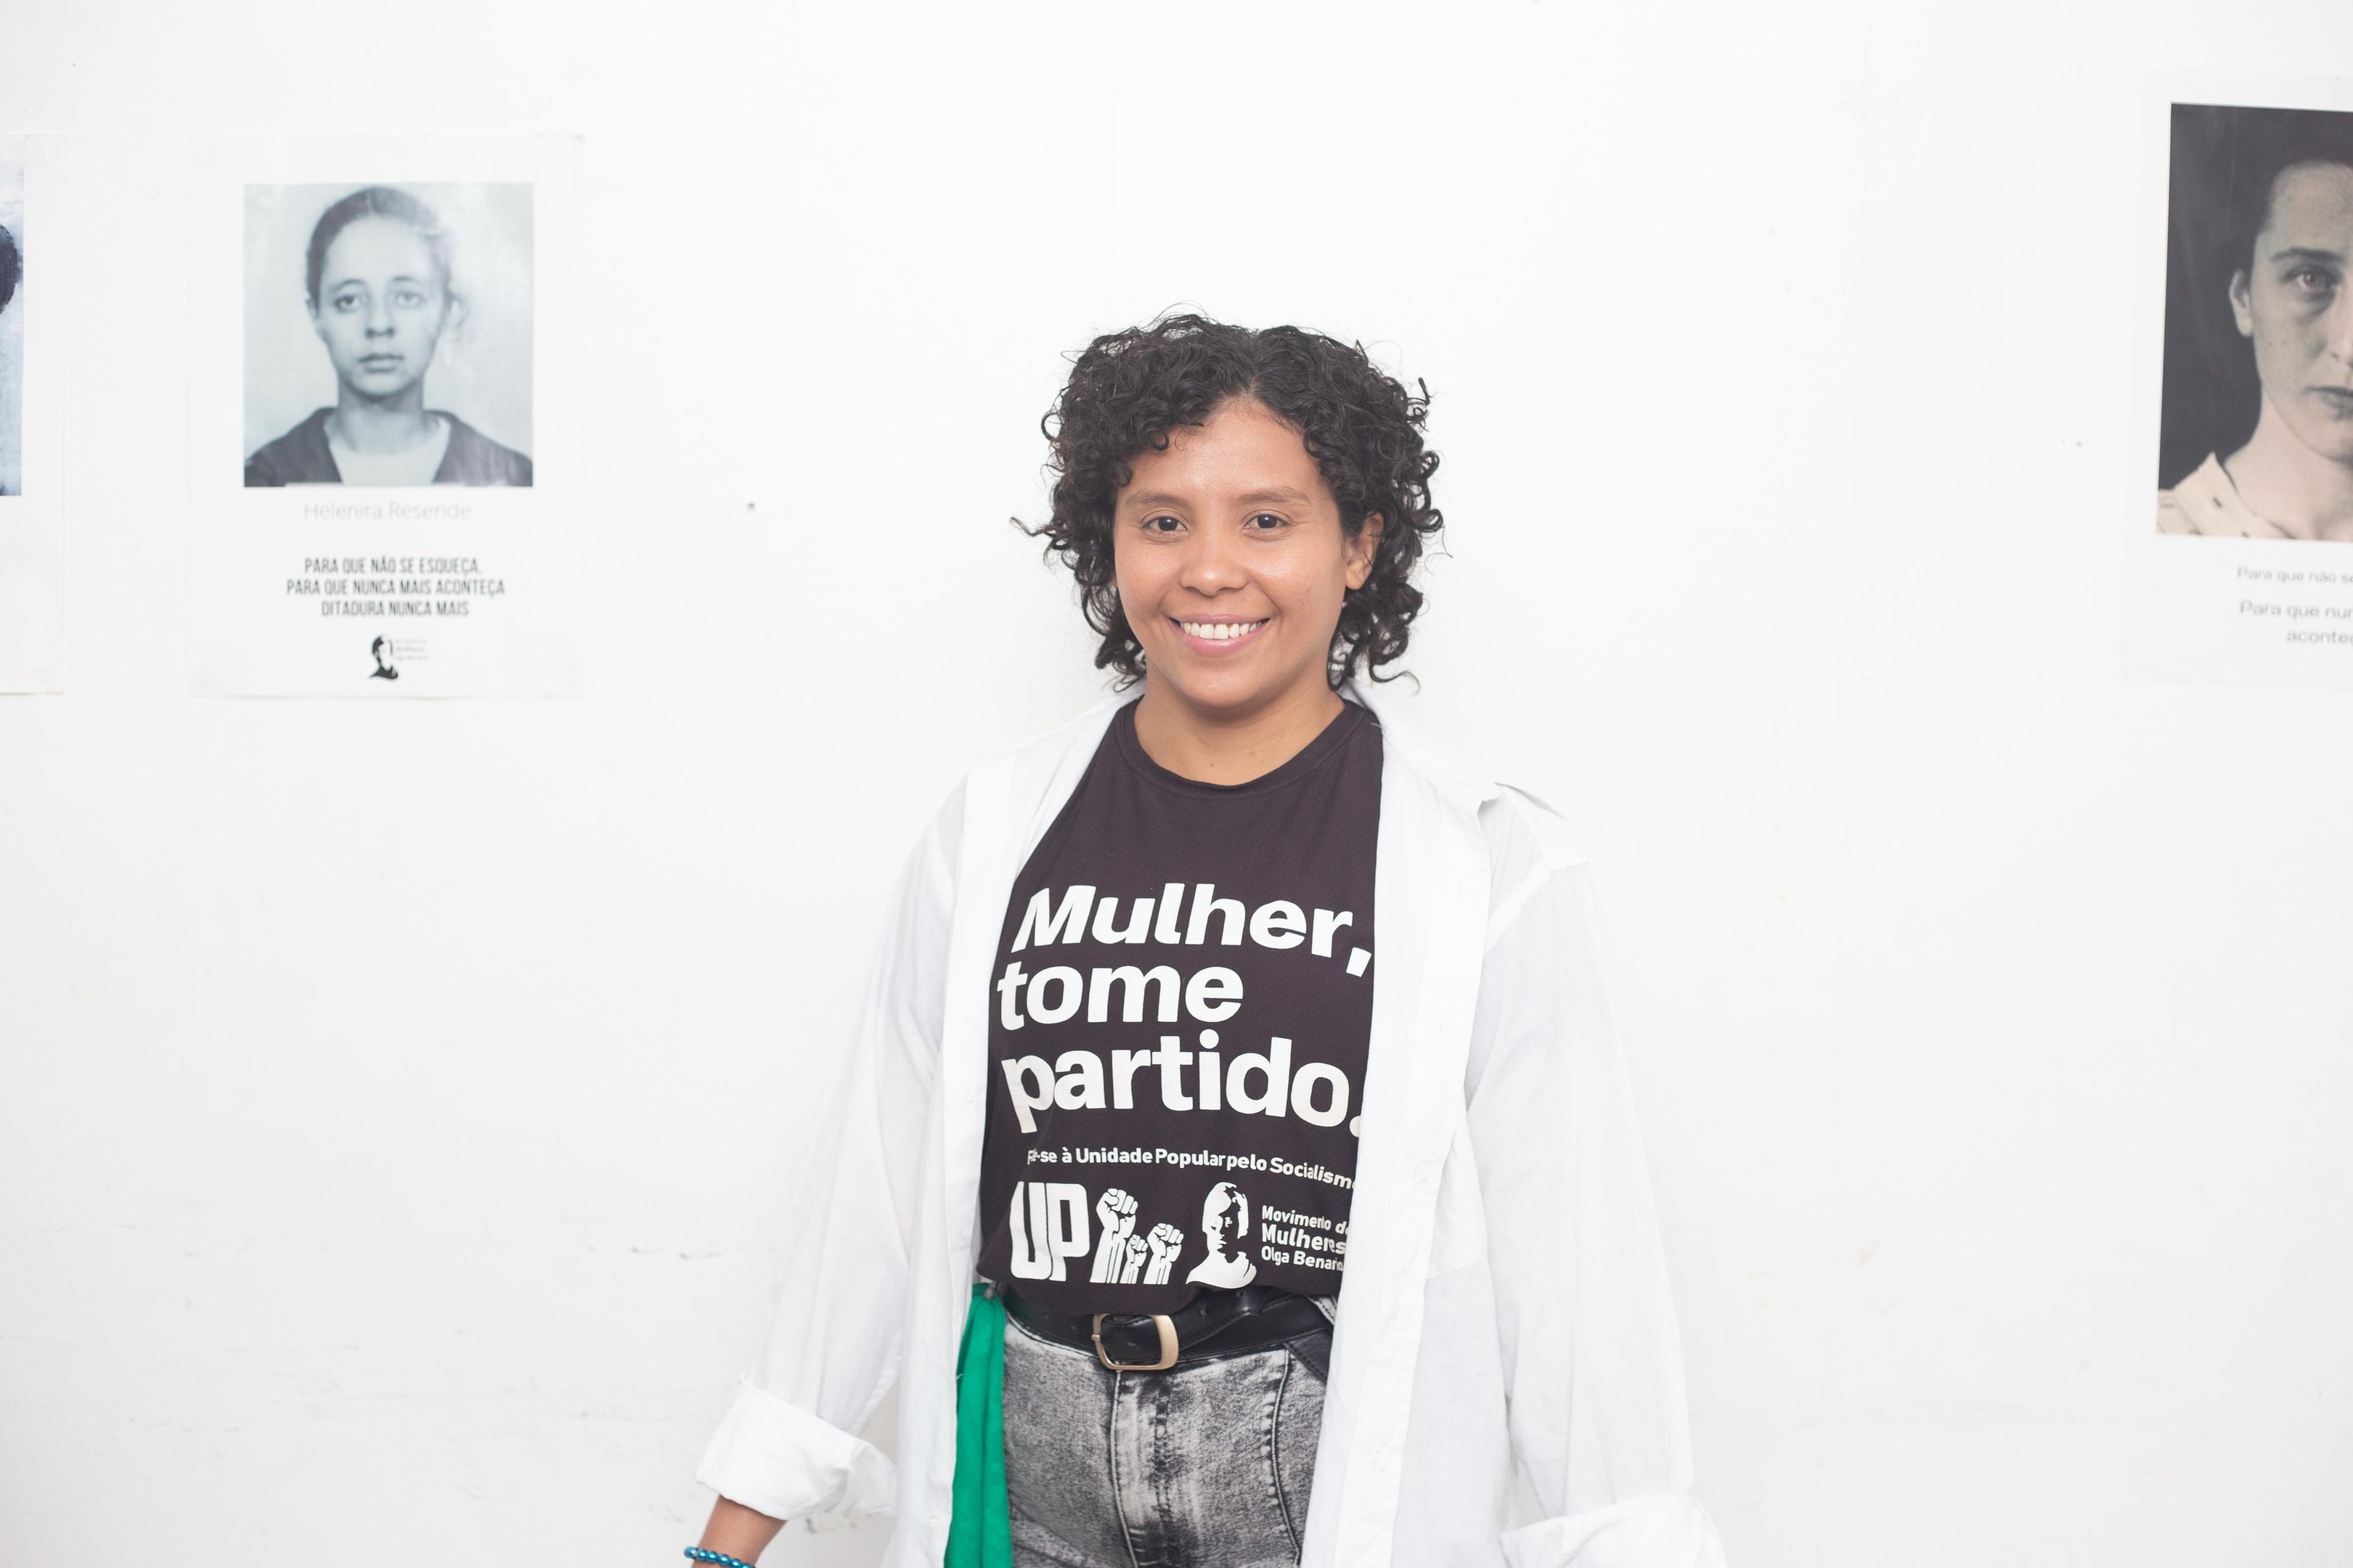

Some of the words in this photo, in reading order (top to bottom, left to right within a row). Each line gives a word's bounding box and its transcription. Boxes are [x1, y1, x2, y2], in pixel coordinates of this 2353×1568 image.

[303, 501, 383, 520] Helenira
[388, 501, 472, 520] Resende
[305, 558, 338, 573] PARA
[343, 558, 365, 573] QUE
[371, 555, 396, 573] NÃO
[400, 558, 414, 573] SE
[2237, 565, 2272, 579] Para
[2277, 571, 2304, 583] que
[2310, 571, 2336, 583] não
[287, 580, 320, 595] PARA
[325, 580, 348, 595] QUE
[353, 580, 394, 595] NUNCA
[399, 580, 431, 595] MAIS
[436, 580, 505, 597] ACONTEÇA
[322, 601, 385, 616] DITADURA
[388, 601, 431, 616] NUNCA
[436, 601, 469, 616] MAIS
[2240, 599, 2281, 615] Para
[2287, 605, 2320, 619] que
[1011, 883, 1371, 977] Mulher,
[997, 961, 1243, 1030] tome
[1062, 1146, 1072, 1163] à
[1076, 1148, 1153, 1163] Unidade
[1155, 1148, 1226, 1168] Popular
[1227, 1154, 1267, 1171] pelo
[1270, 1157, 1355, 1190] Socialism
[1009, 1181, 1090, 1281] UP
[1262, 1222, 1346, 1254] Mulheres
[1261, 1246, 1289, 1266] Olga
